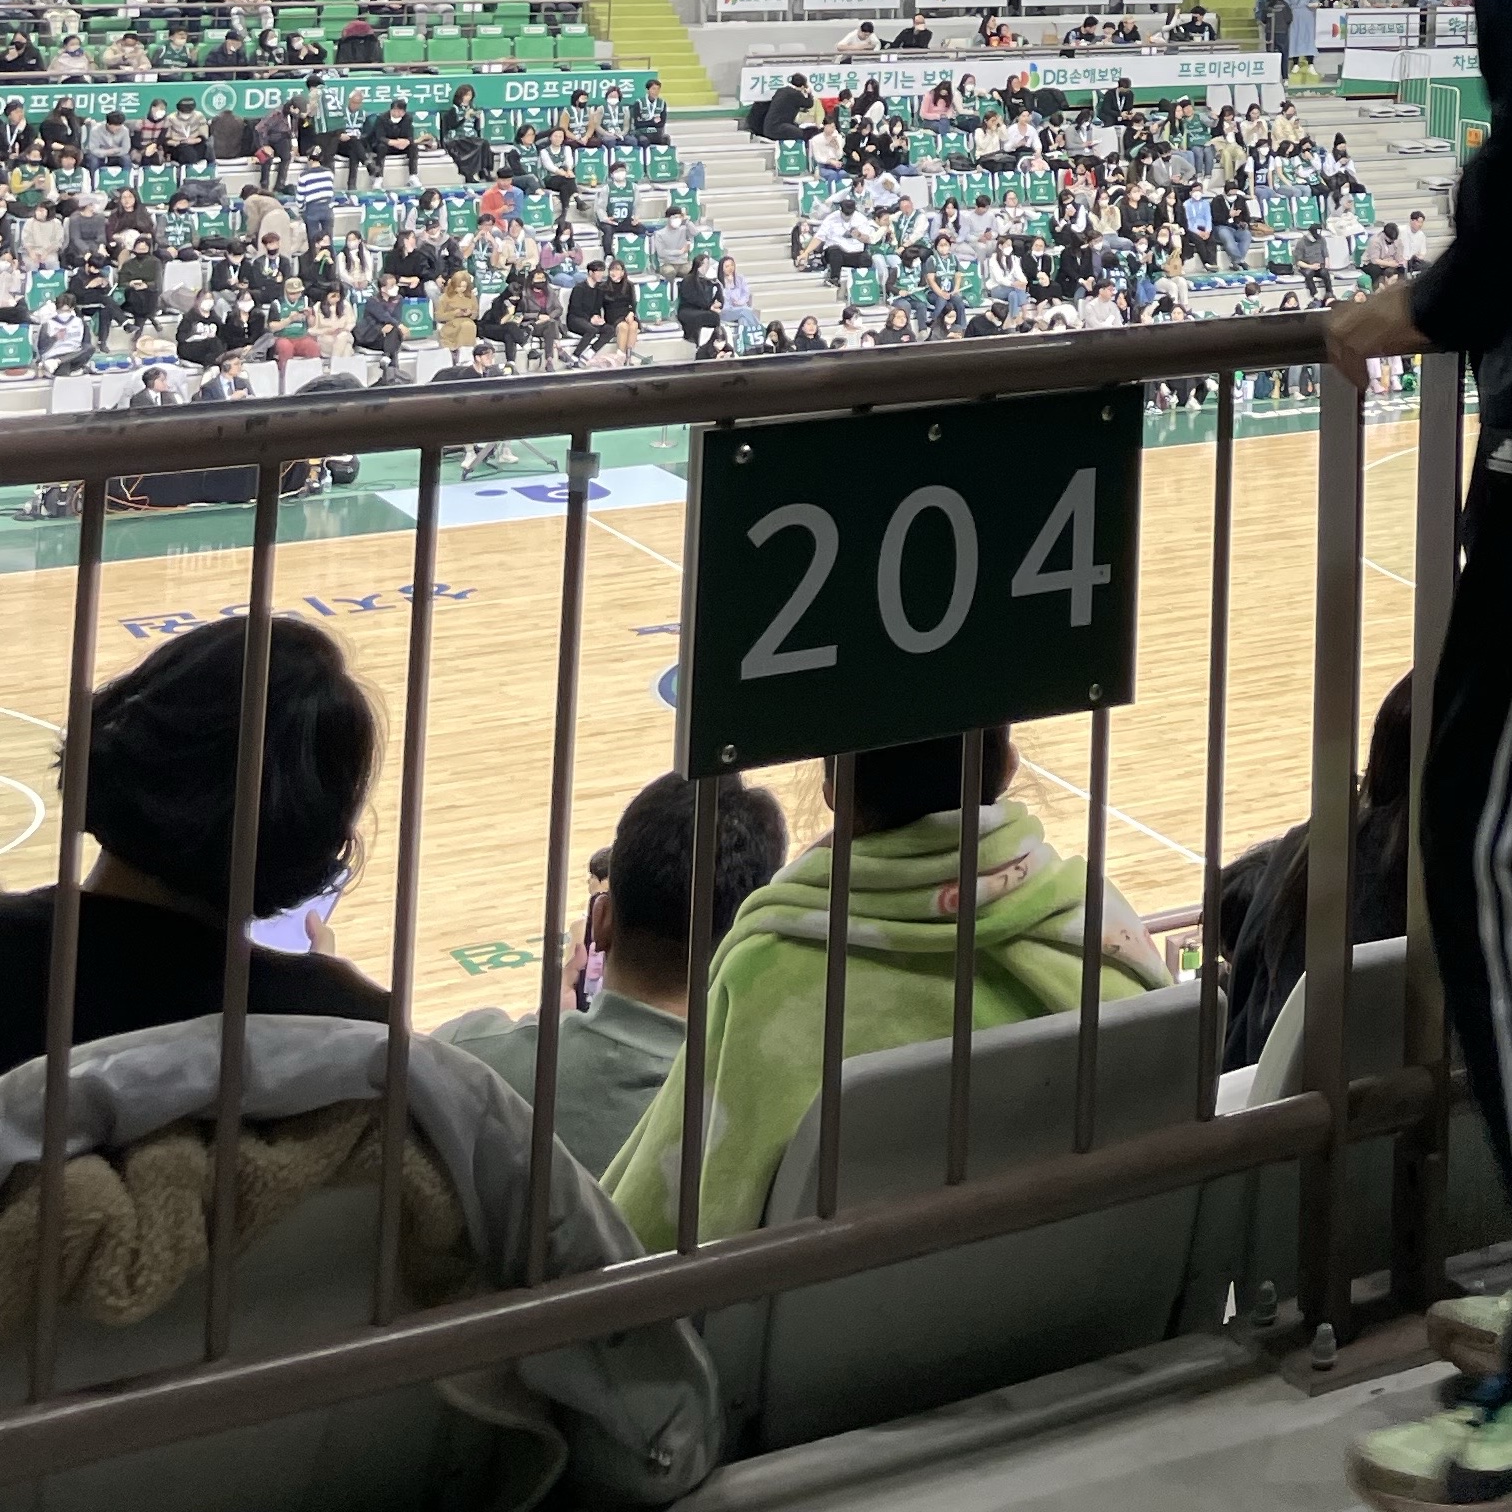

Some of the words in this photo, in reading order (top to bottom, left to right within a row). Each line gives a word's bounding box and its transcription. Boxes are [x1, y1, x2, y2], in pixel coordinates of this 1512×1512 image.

[1043, 66, 1123, 86] DB손해보험
[1178, 60, 1265, 78] 프로미라이프
[505, 80, 539, 102] DB
[750, 72, 795, 94] 가족
[810, 71, 859, 92] 행복을
[244, 89, 282, 110] DB
[741, 467, 1111, 680] 204
